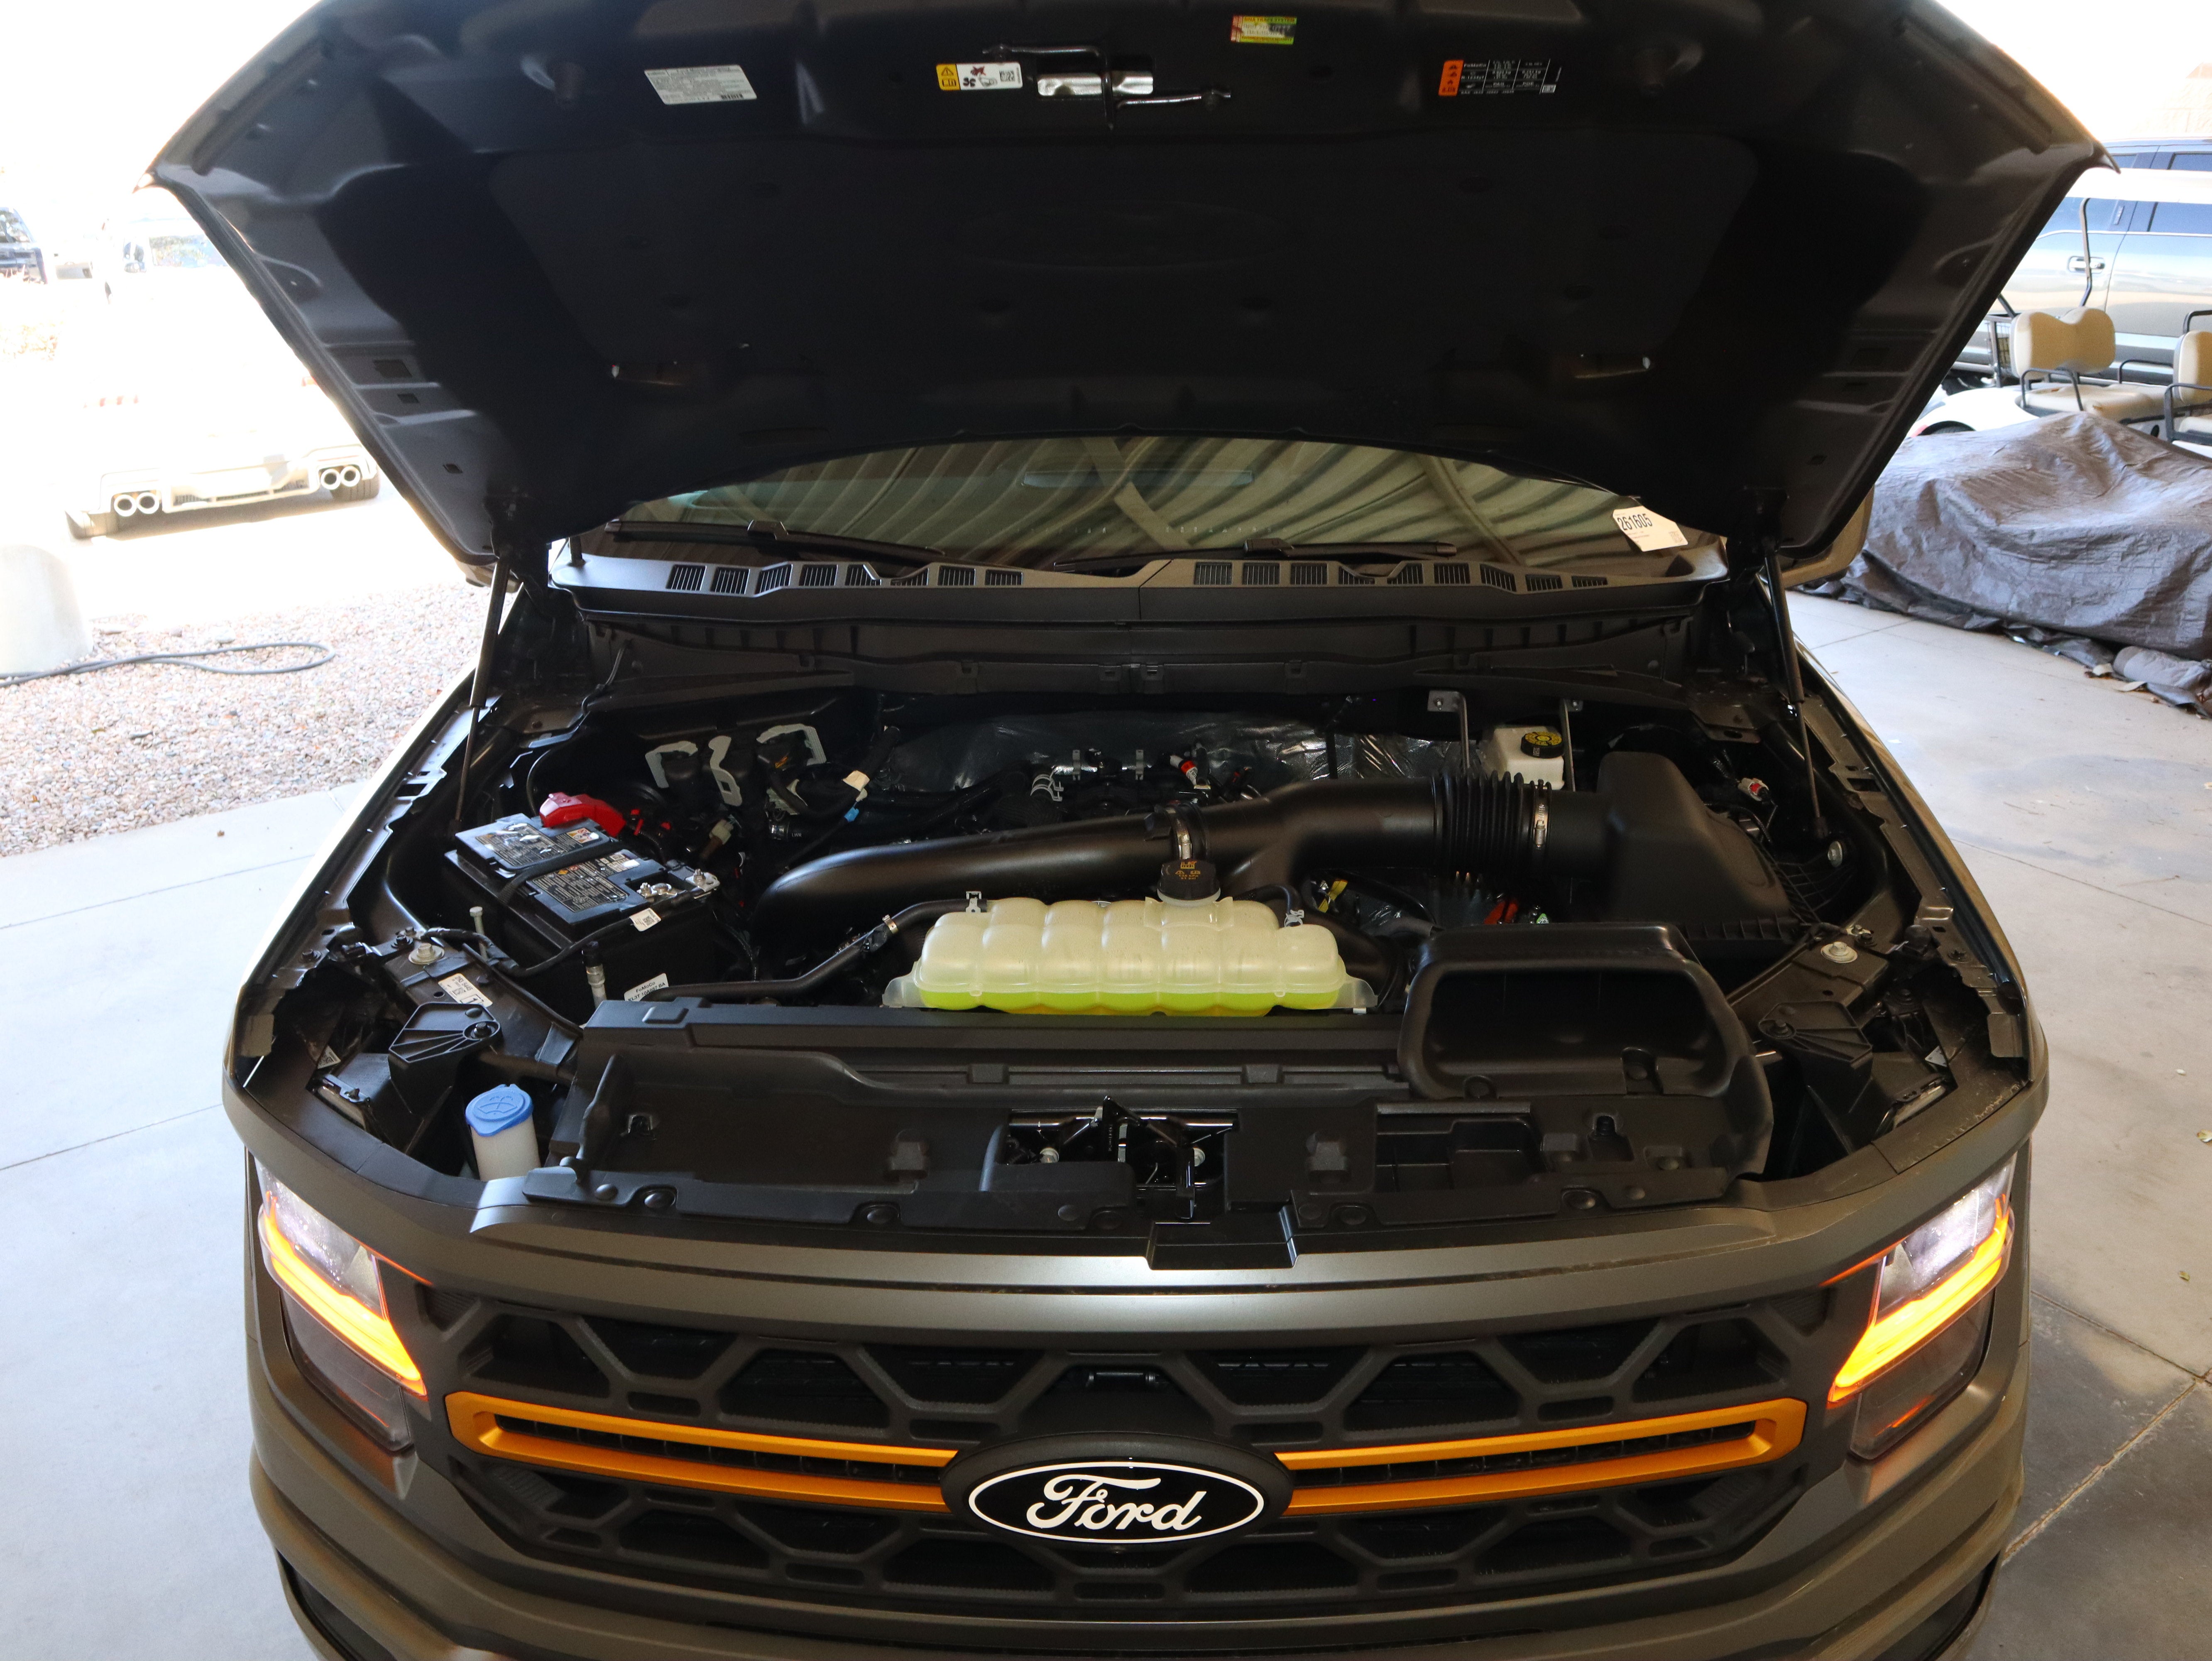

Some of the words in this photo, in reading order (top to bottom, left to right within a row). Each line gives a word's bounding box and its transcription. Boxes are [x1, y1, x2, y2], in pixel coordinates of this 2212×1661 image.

[1617, 513, 1652, 530] 261605
[636, 982, 655, 993] FoMoCo
[1026, 1474, 1207, 1531] Ford
